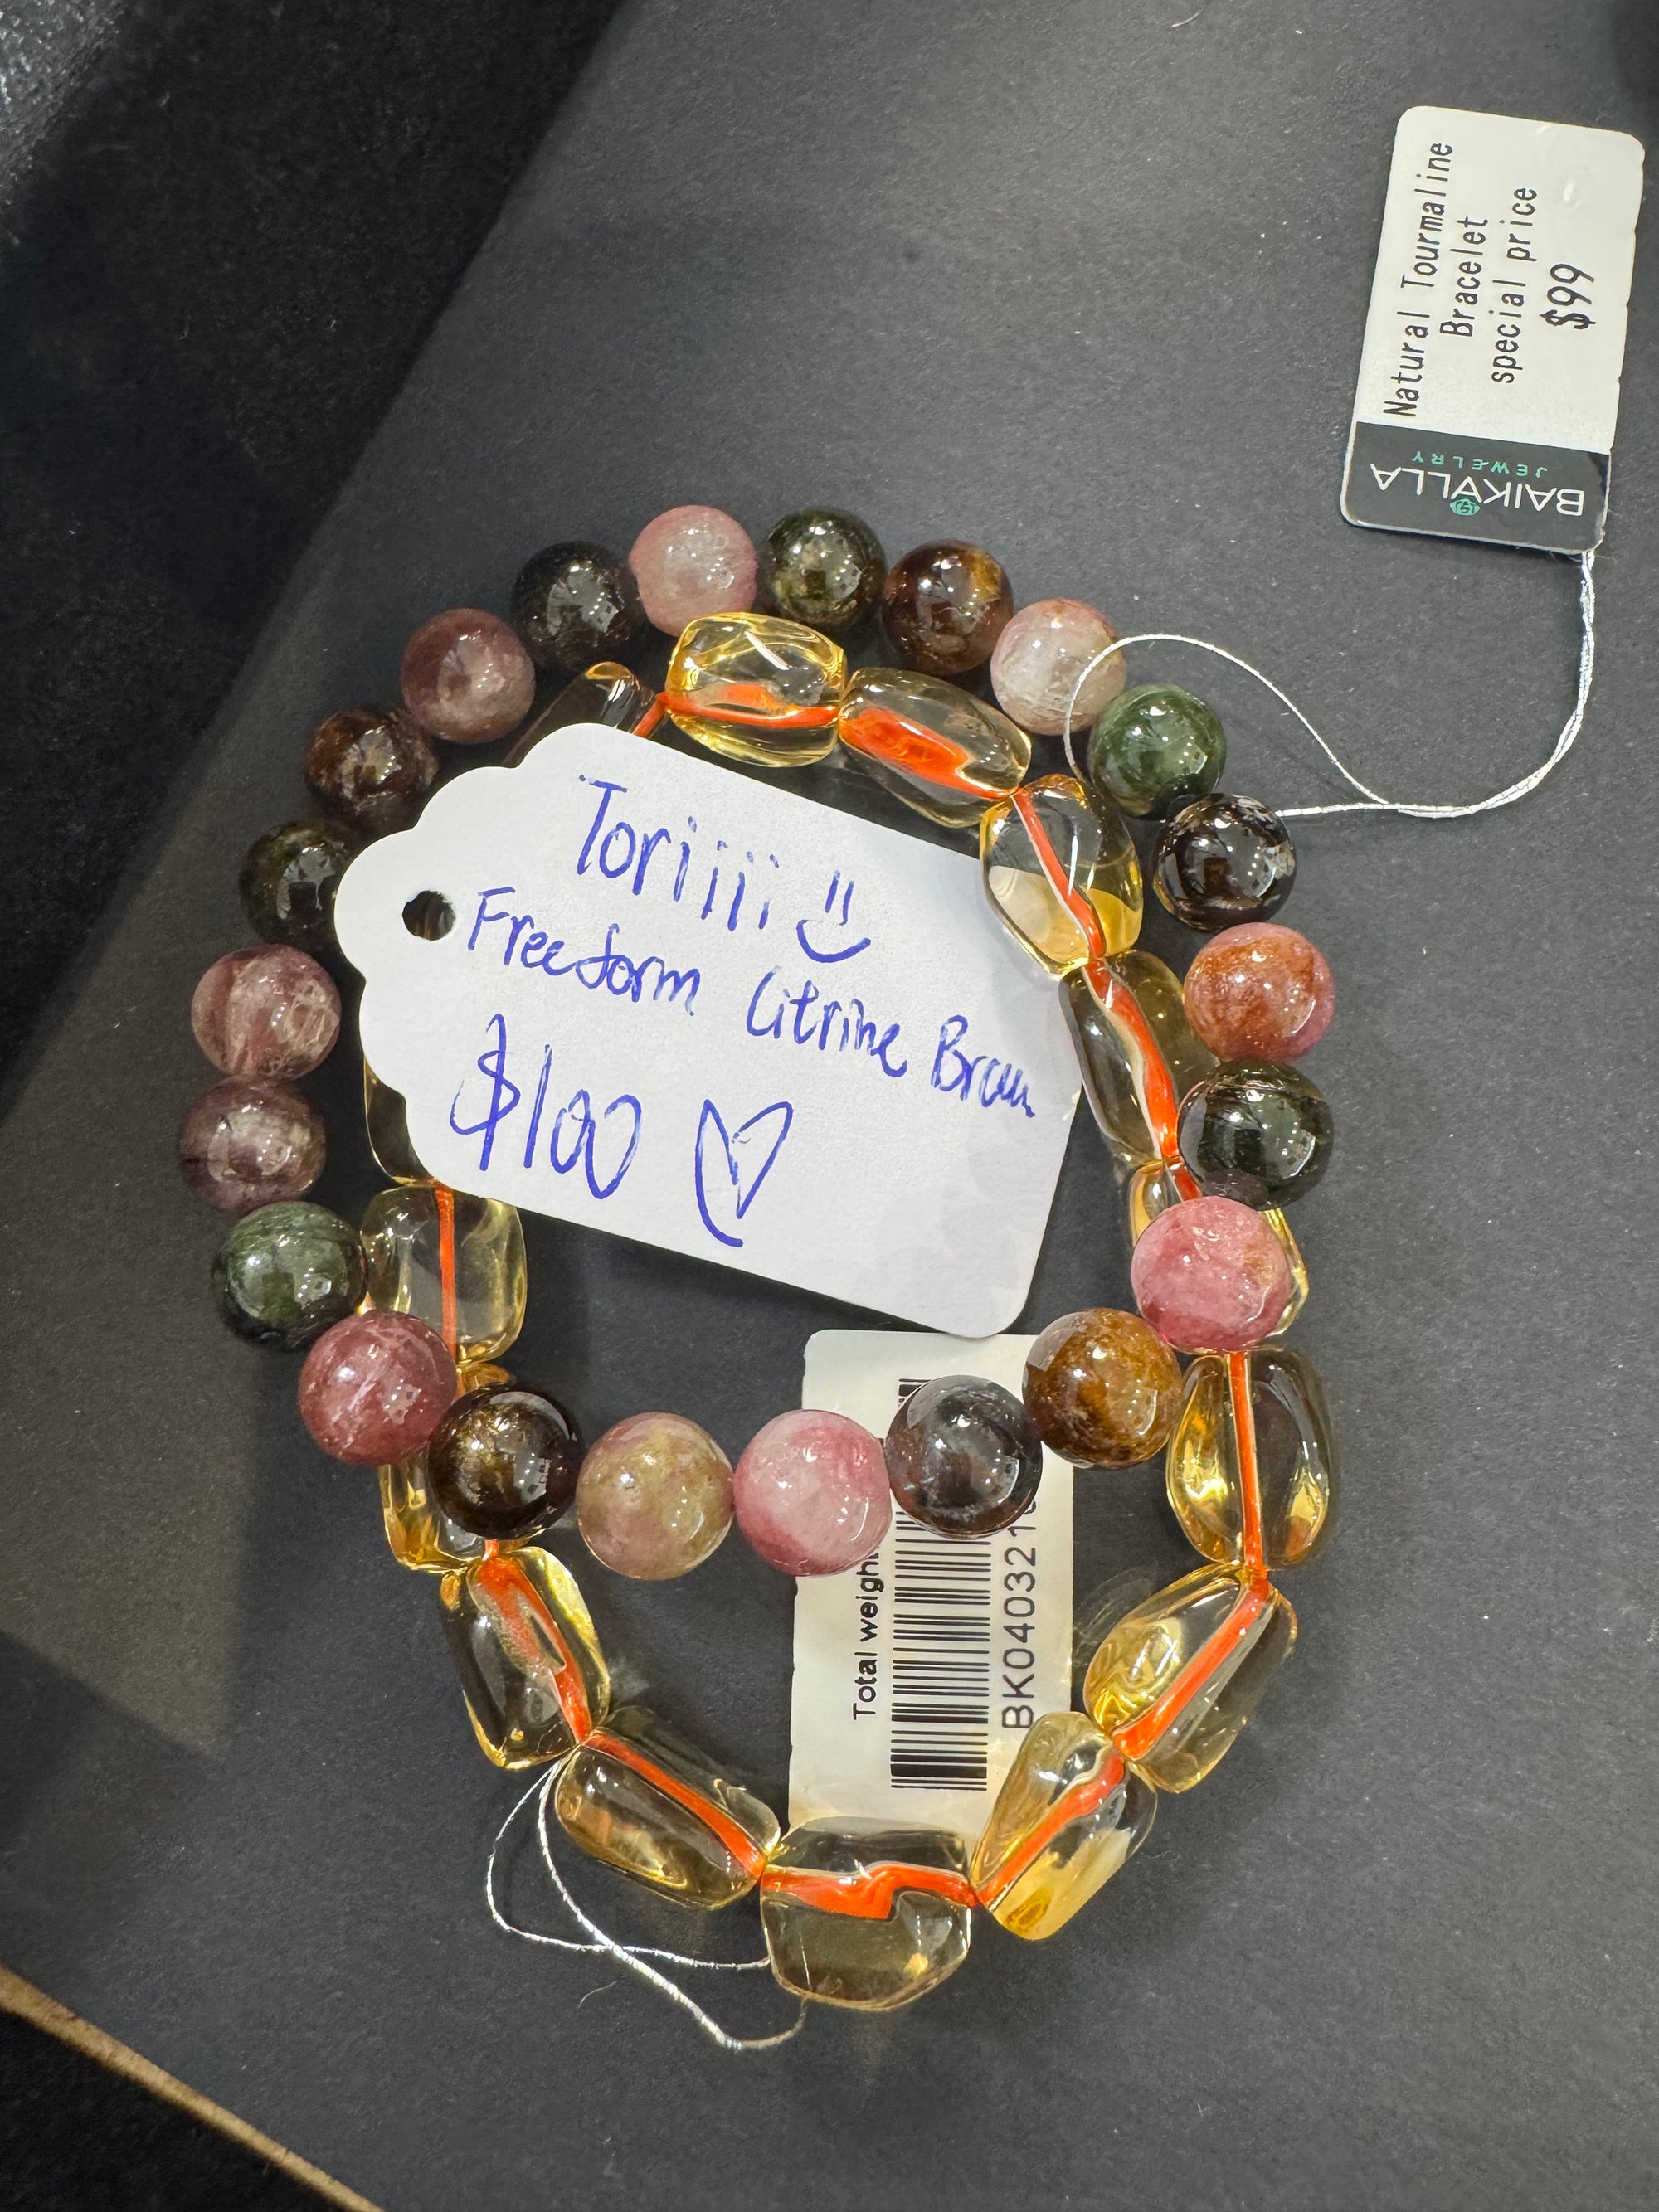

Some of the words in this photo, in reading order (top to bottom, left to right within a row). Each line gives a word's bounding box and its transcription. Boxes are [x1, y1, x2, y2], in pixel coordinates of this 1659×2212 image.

[1400, 141, 1453, 289] Tourmaline
[1498, 186, 1538, 262] price
[1439, 215, 1489, 338] Bracelet
[1539, 262, 1597, 330] $99
[1383, 310, 1430, 417] Natural
[1488, 280, 1526, 384] special
[1411, 450, 1548, 479] JEWELRY
[450, 1014, 642, 1200] $100
[852, 1650, 878, 1720] Total
